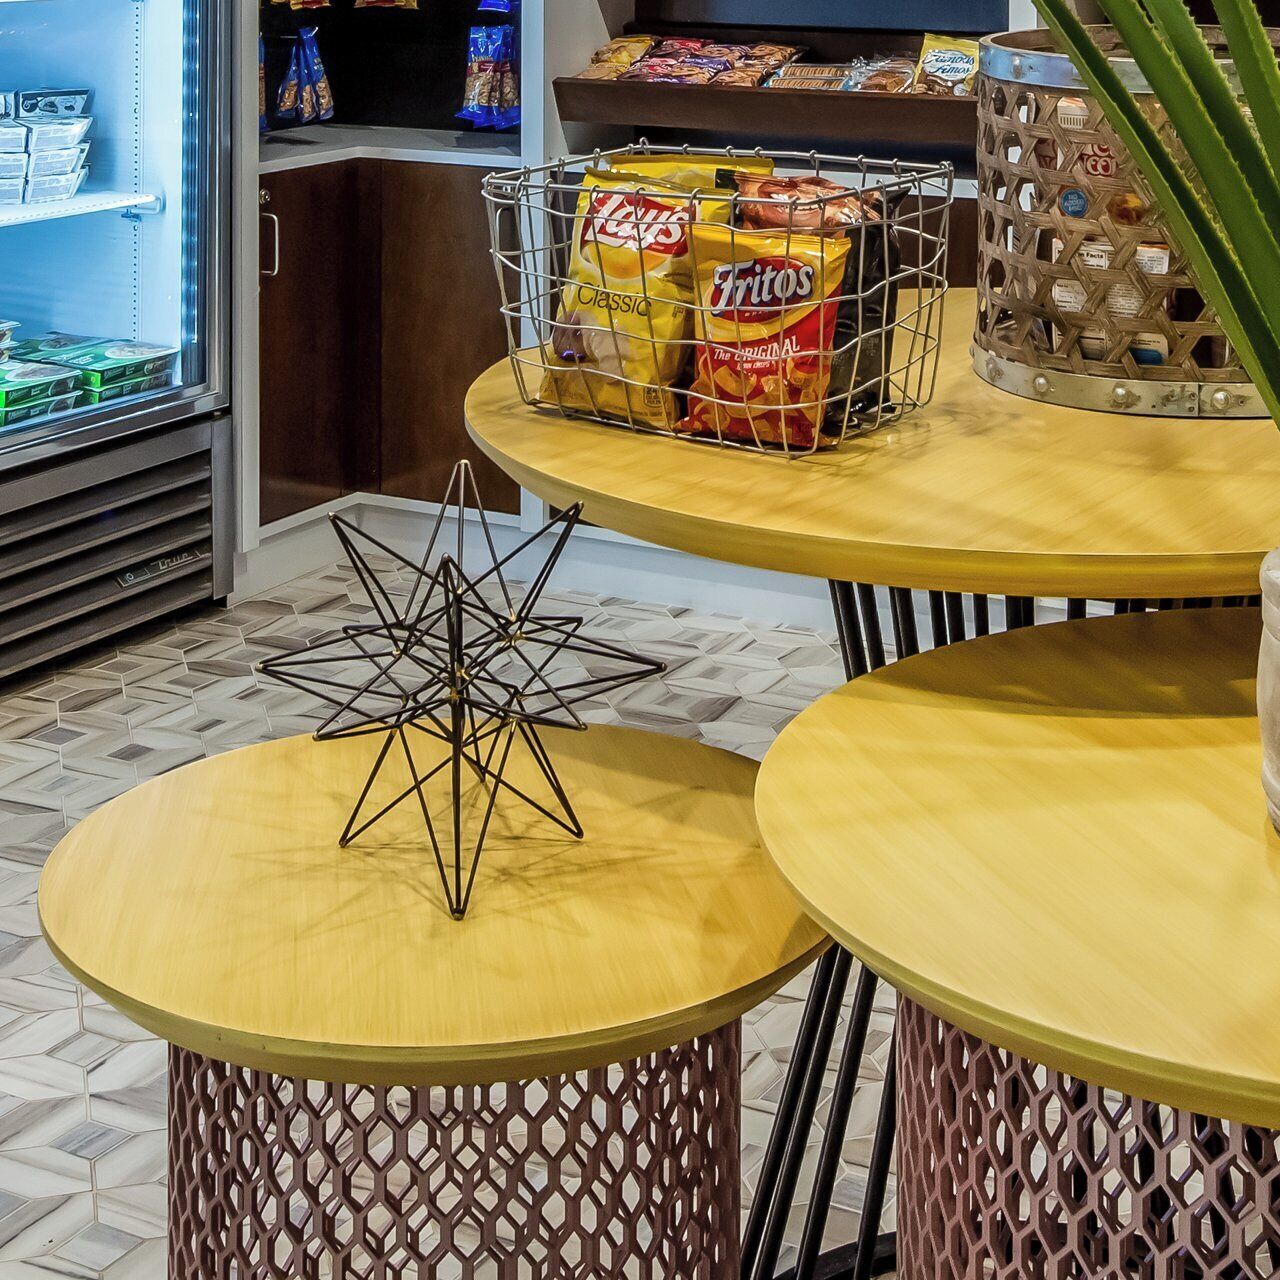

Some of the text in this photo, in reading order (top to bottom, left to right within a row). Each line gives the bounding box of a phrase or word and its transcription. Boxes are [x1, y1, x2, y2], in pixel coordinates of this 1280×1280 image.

[584, 192, 691, 250] Lay's
[1085, 251, 1105, 259] Facts
[577, 281, 652, 317] Classic
[711, 259, 814, 316] Fritos
[734, 335, 801, 362] ORIGINAL
